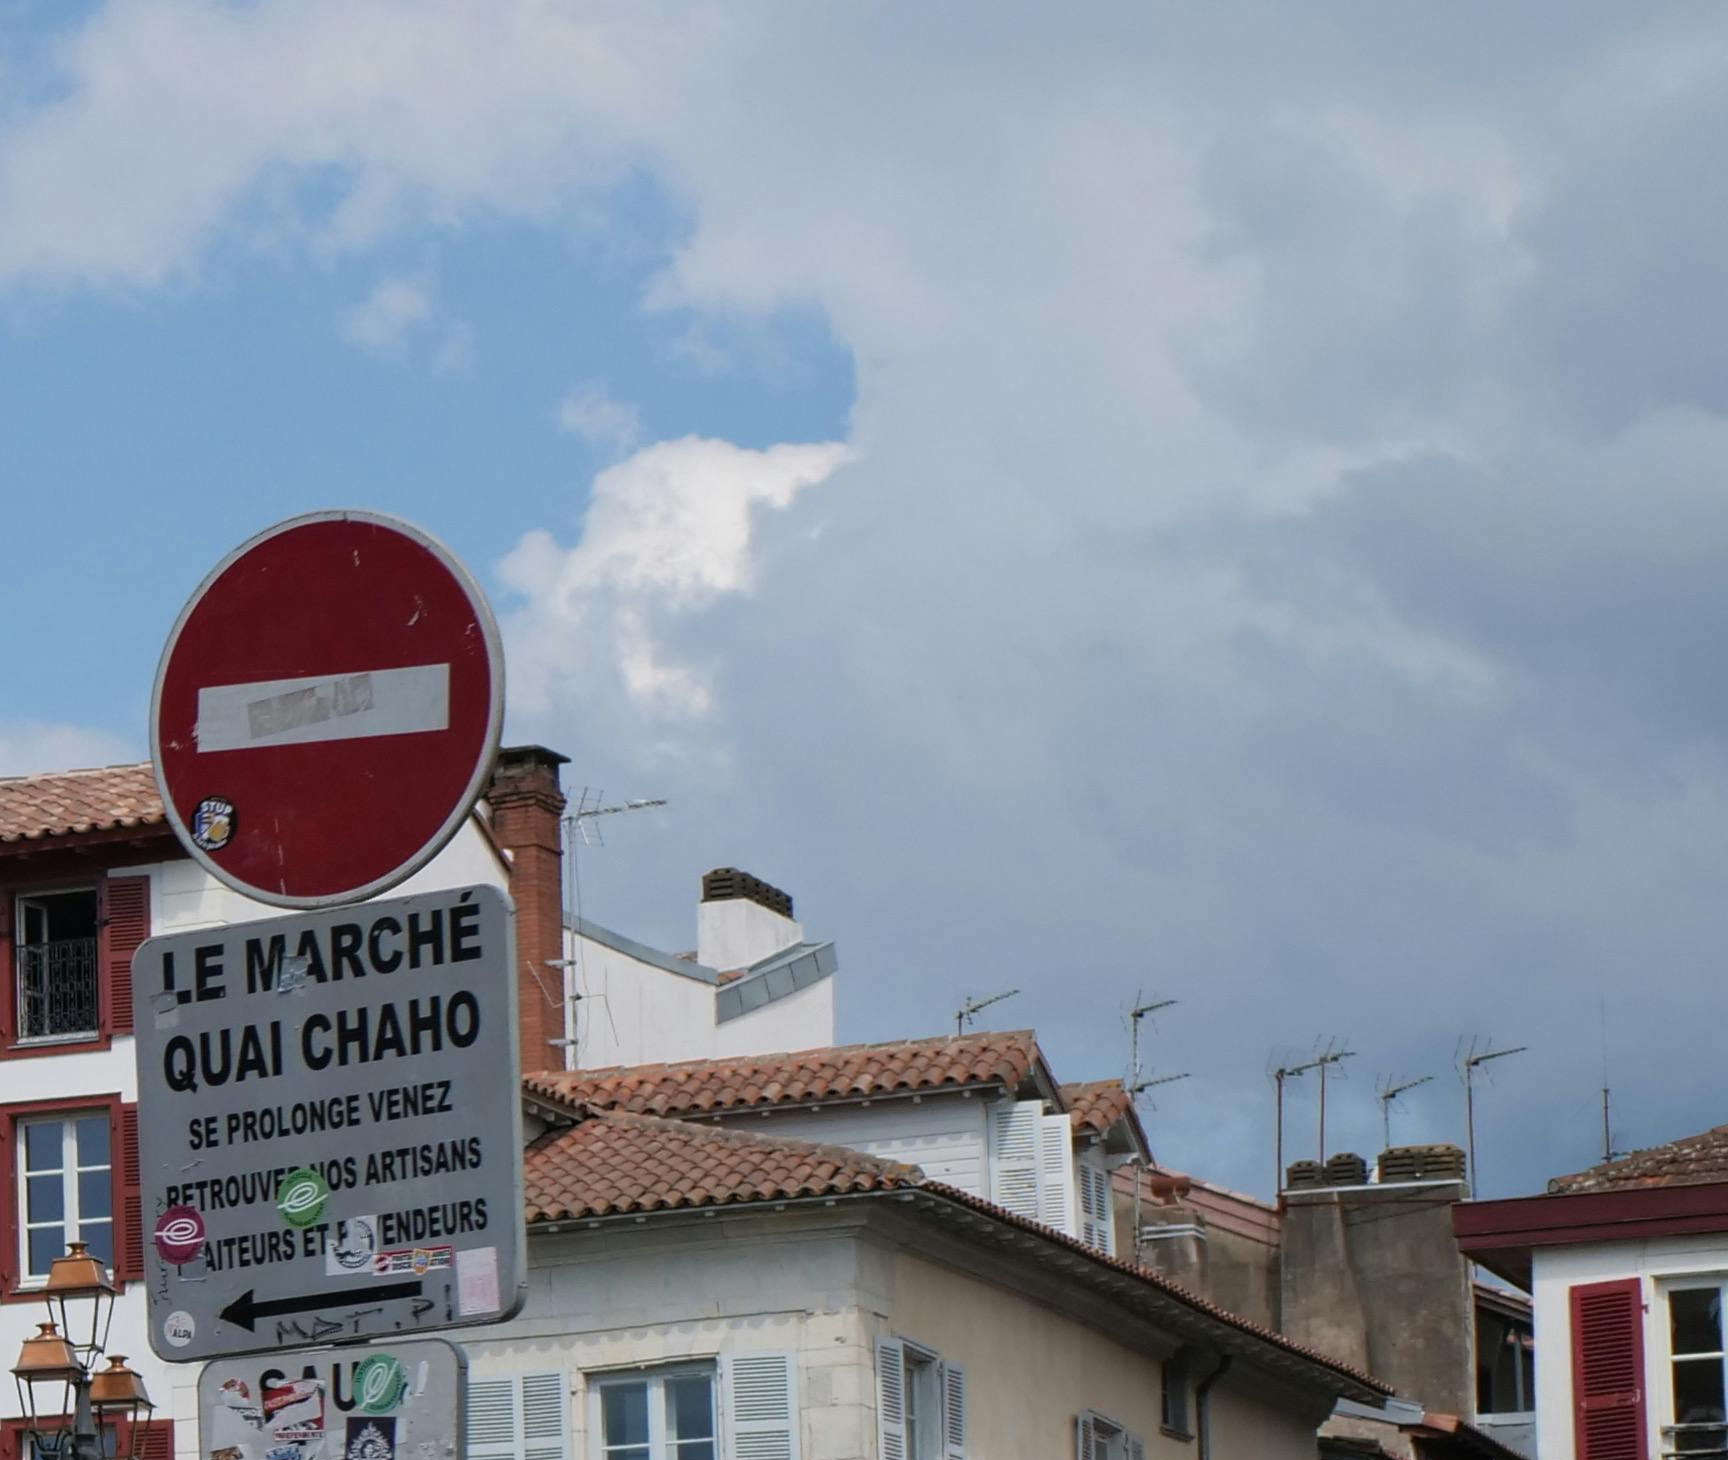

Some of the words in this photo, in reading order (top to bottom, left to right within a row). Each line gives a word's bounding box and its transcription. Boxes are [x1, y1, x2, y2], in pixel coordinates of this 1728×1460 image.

[161, 943, 226, 1004] LE
[245, 891, 483, 994] MARCHÉ
[162, 1020, 284, 1094] QUAI
[301, 990, 481, 1071] CHAHO
[188, 1117, 219, 1151] SE
[226, 1094, 362, 1146] PROLONGE
[367, 1079, 453, 1124] VENEZ
[166, 1164, 302, 1212] RETROUVE
[364, 1137, 482, 1187] ARTISANS
[302, 1223, 330, 1258] ET
